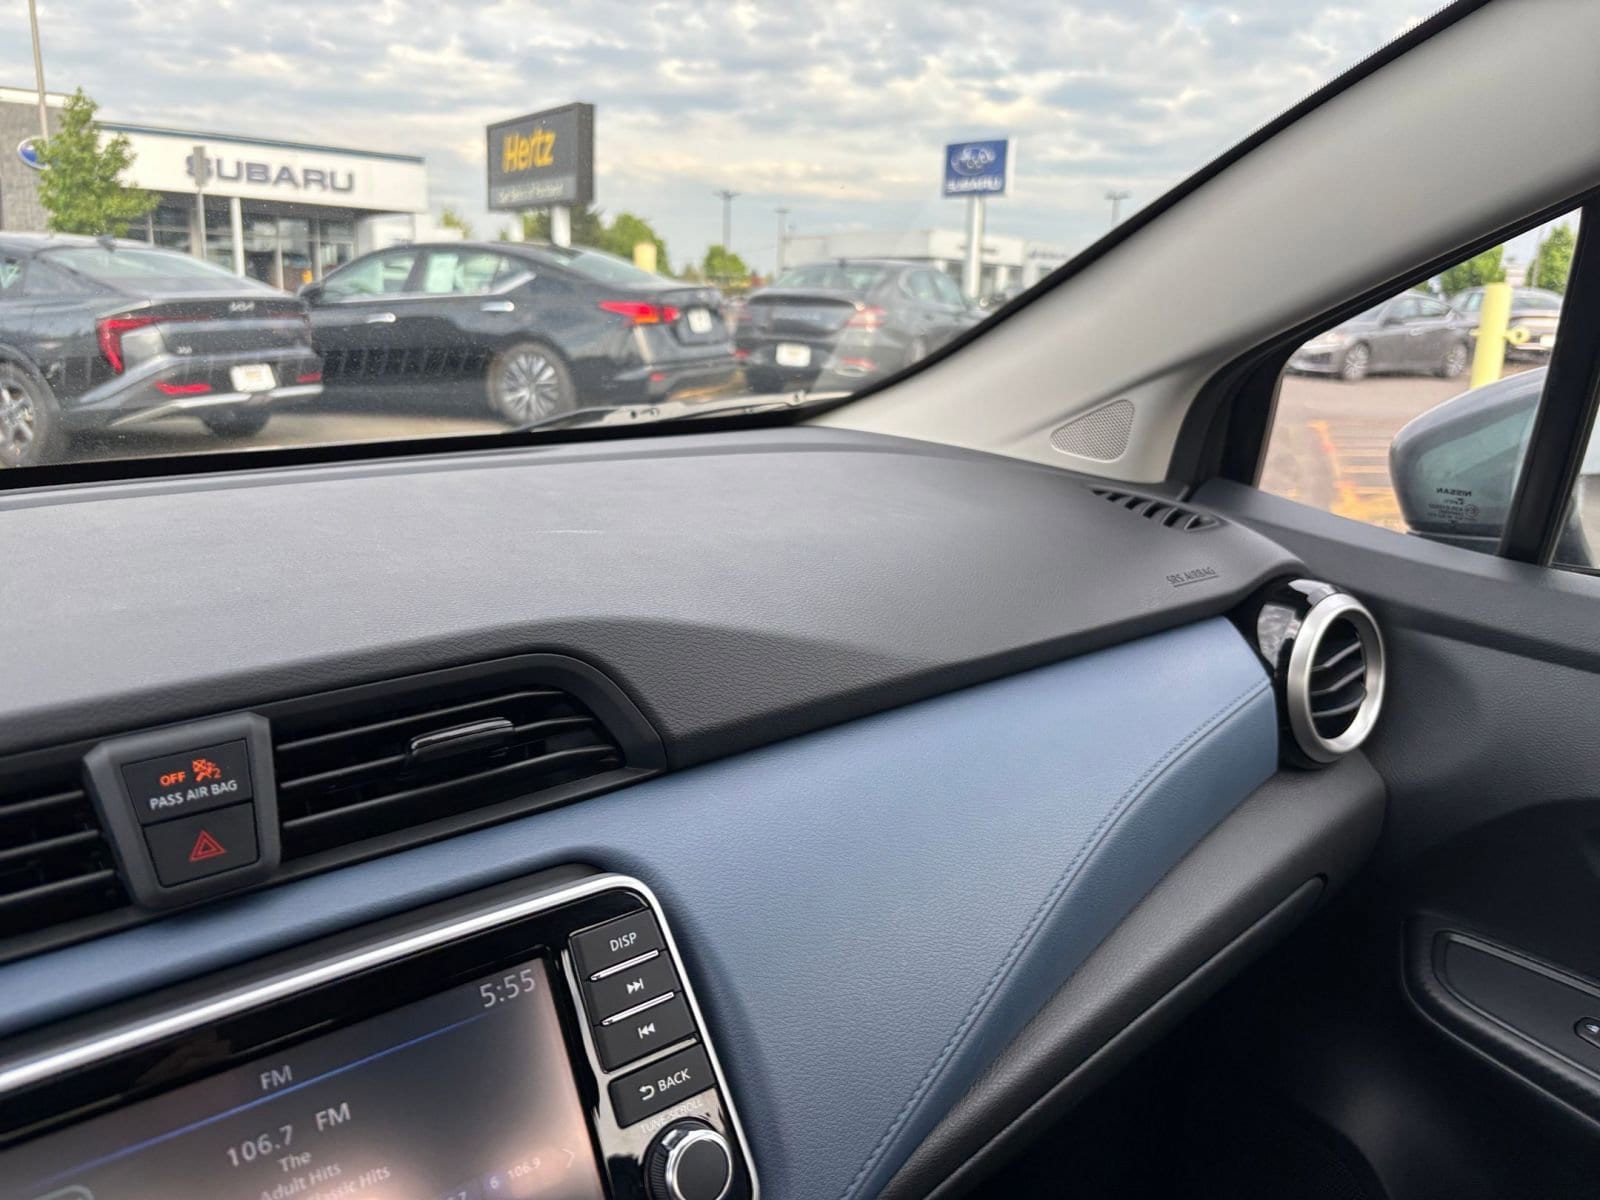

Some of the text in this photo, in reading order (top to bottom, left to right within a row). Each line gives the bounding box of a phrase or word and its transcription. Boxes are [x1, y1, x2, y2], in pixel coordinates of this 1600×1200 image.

[503, 128, 557, 174] Hertz
[160, 771, 187, 786] OFF
[150, 780, 238, 810] PASS AIR BAG
[609, 932, 637, 952] DISP
[480, 968, 536, 1008] 5:55
[260, 1064, 293, 1090] FM
[657, 1068, 691, 1092] BACK
[226, 1102, 351, 1167] 106.7 FM
[277, 1151, 312, 1172] The
[261, 1163, 342, 1200] Adult Hits
[358, 1166, 391, 1189] Hits
